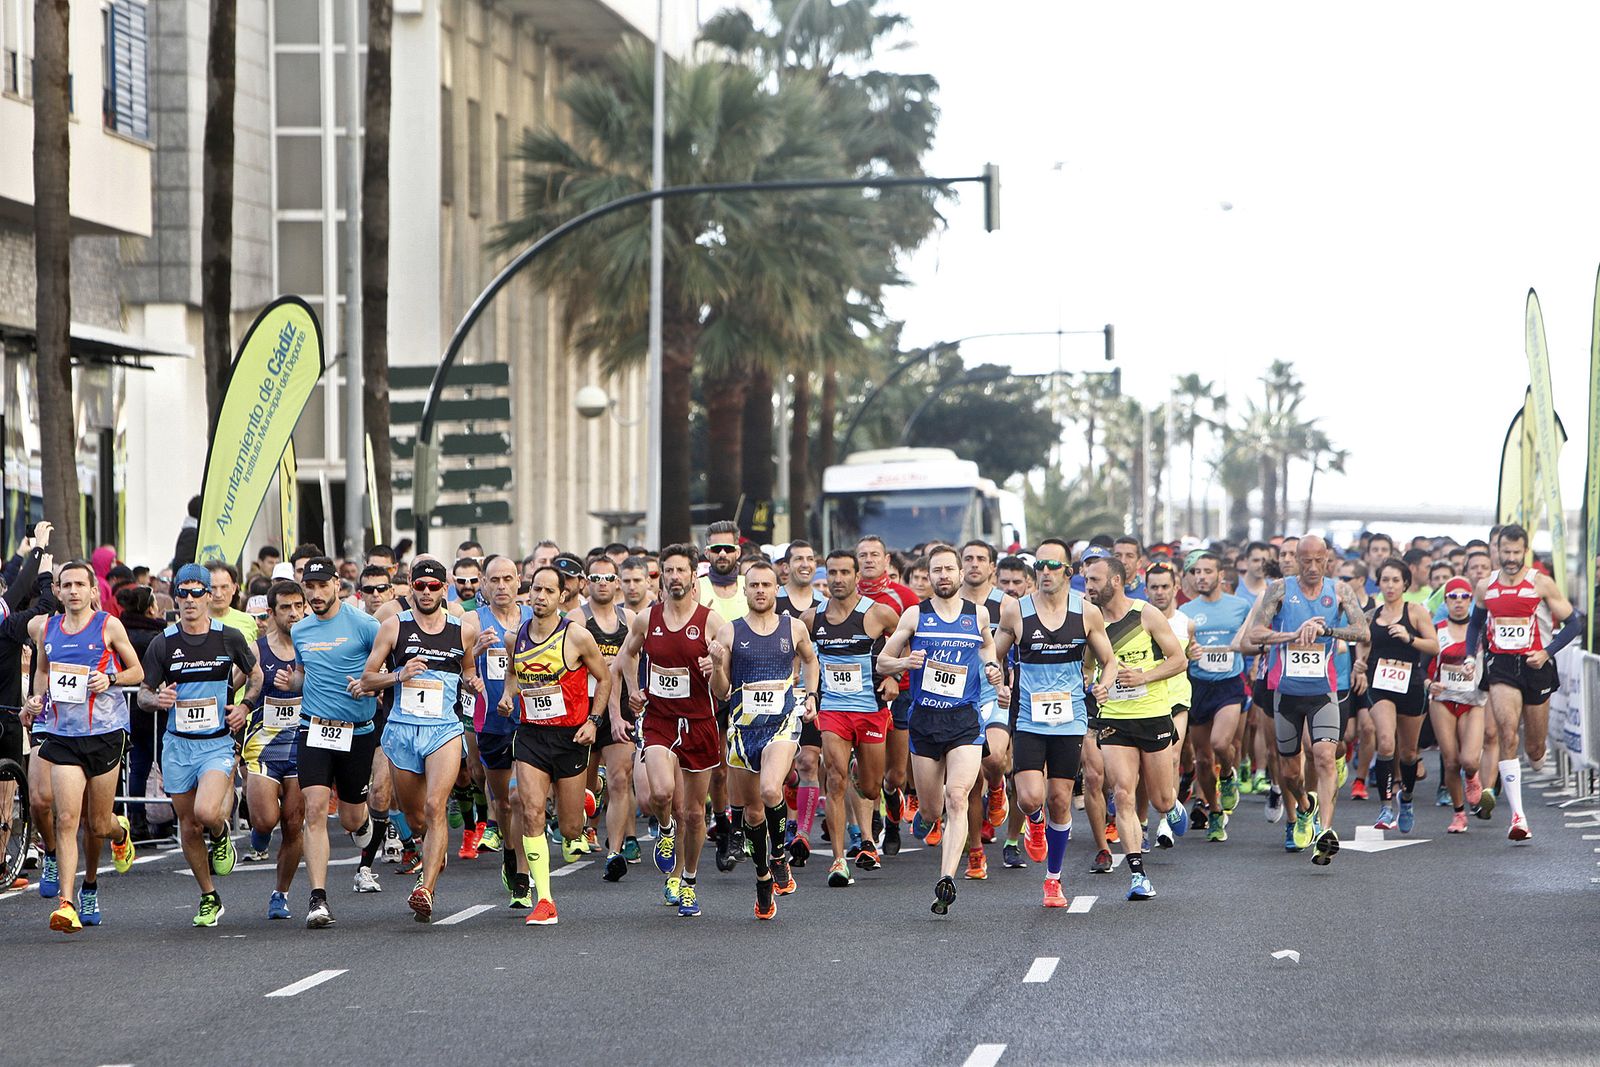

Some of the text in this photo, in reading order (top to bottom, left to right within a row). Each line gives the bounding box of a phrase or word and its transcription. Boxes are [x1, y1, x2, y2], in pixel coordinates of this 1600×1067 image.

[243, 330, 306, 484] Instituto Municipal del Deporte
[216, 320, 297, 536] Ayuntamiento de Cádiz
[1499, 626, 1525, 638] 320
[1206, 653, 1227, 663] 1020
[1291, 652, 1321, 664] 363
[183, 660, 225, 669] TrailRunner
[833, 672, 851, 682] 548
[934, 670, 957, 685] 506
[1380, 667, 1406, 681] 120
[57, 675, 77, 688] 44
[659, 676, 679, 687] 926
[416, 690, 425, 703] 1
[532, 695, 552, 708] 756
[753, 691, 774, 703] 442
[188, 707, 205, 719] 477
[275, 706, 294, 717] 748
[1042, 702, 1062, 715] 75
[321, 727, 342, 739] 932
